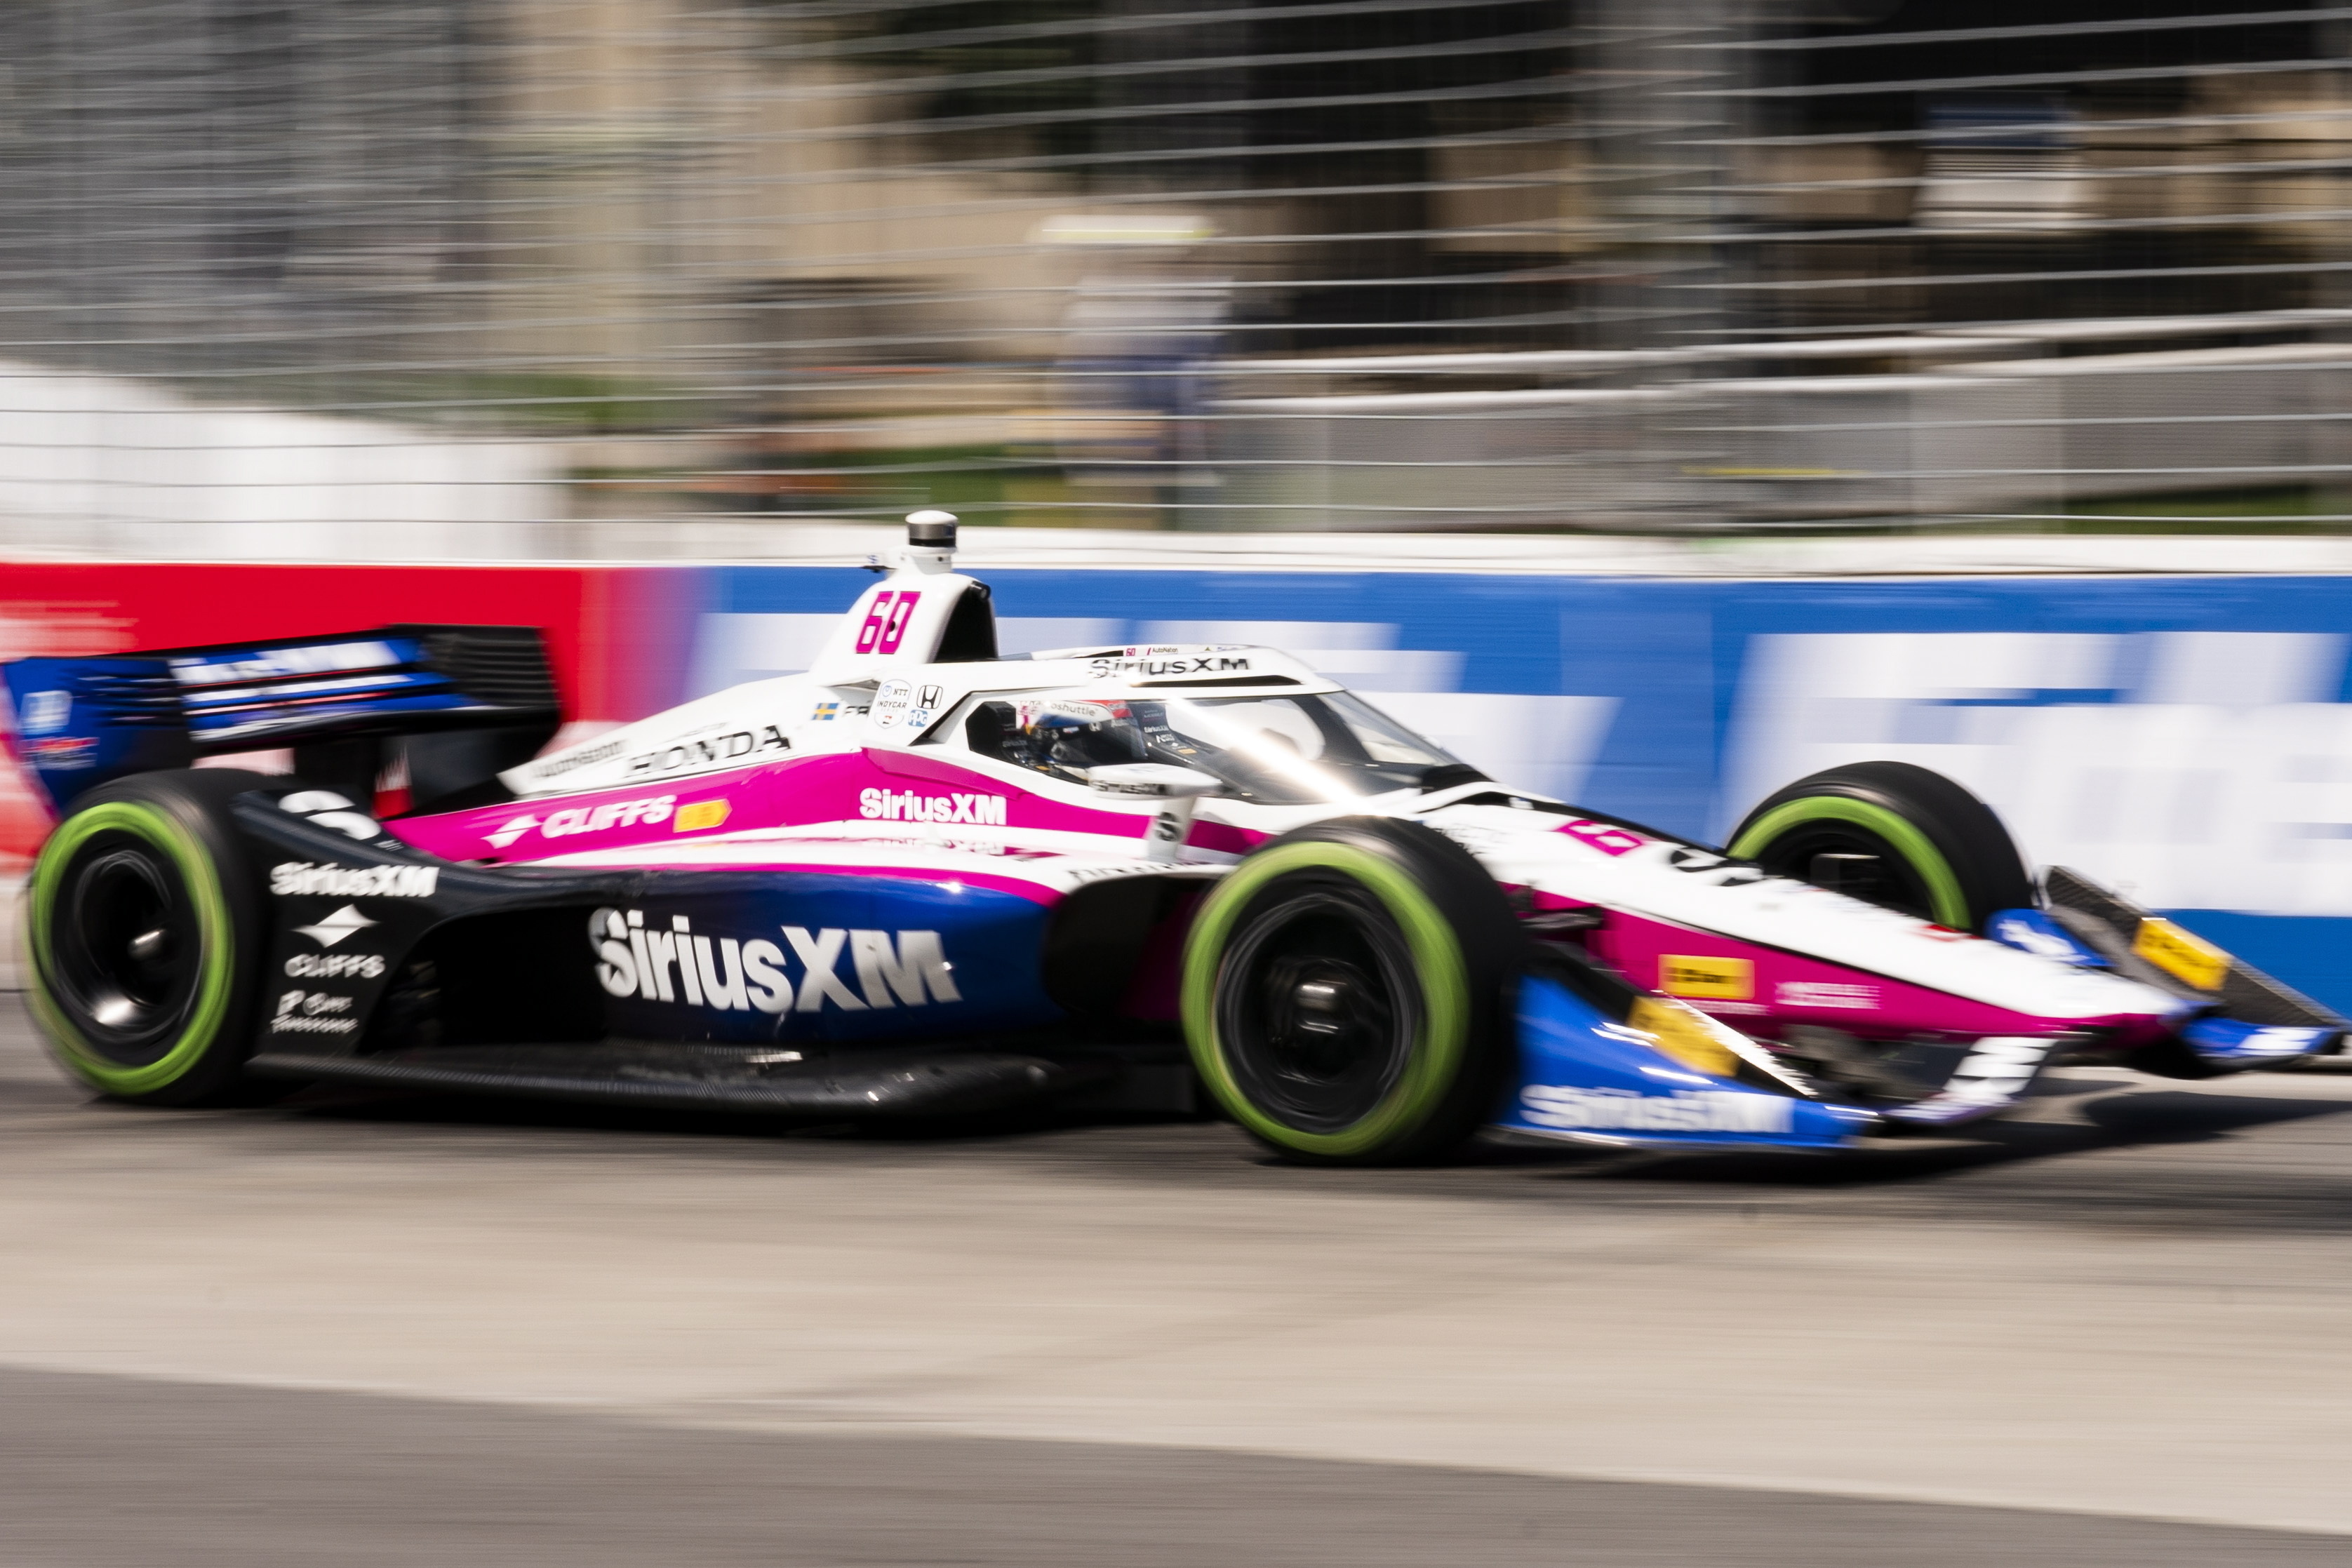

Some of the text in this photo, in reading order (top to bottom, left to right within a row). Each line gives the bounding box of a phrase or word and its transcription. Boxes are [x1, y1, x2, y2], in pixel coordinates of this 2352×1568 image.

[855, 591, 921, 654] 60
[1090, 659, 1249, 678] SiriusXM
[627, 724, 791, 778] HONDA
[540, 795, 677, 838] CLIFFS
[860, 787, 1006, 825] SiriusXM
[269, 862, 440, 897] SiriusXM
[284, 953, 385, 978] CLIFFS
[588, 907, 963, 1014] SiriusXM
